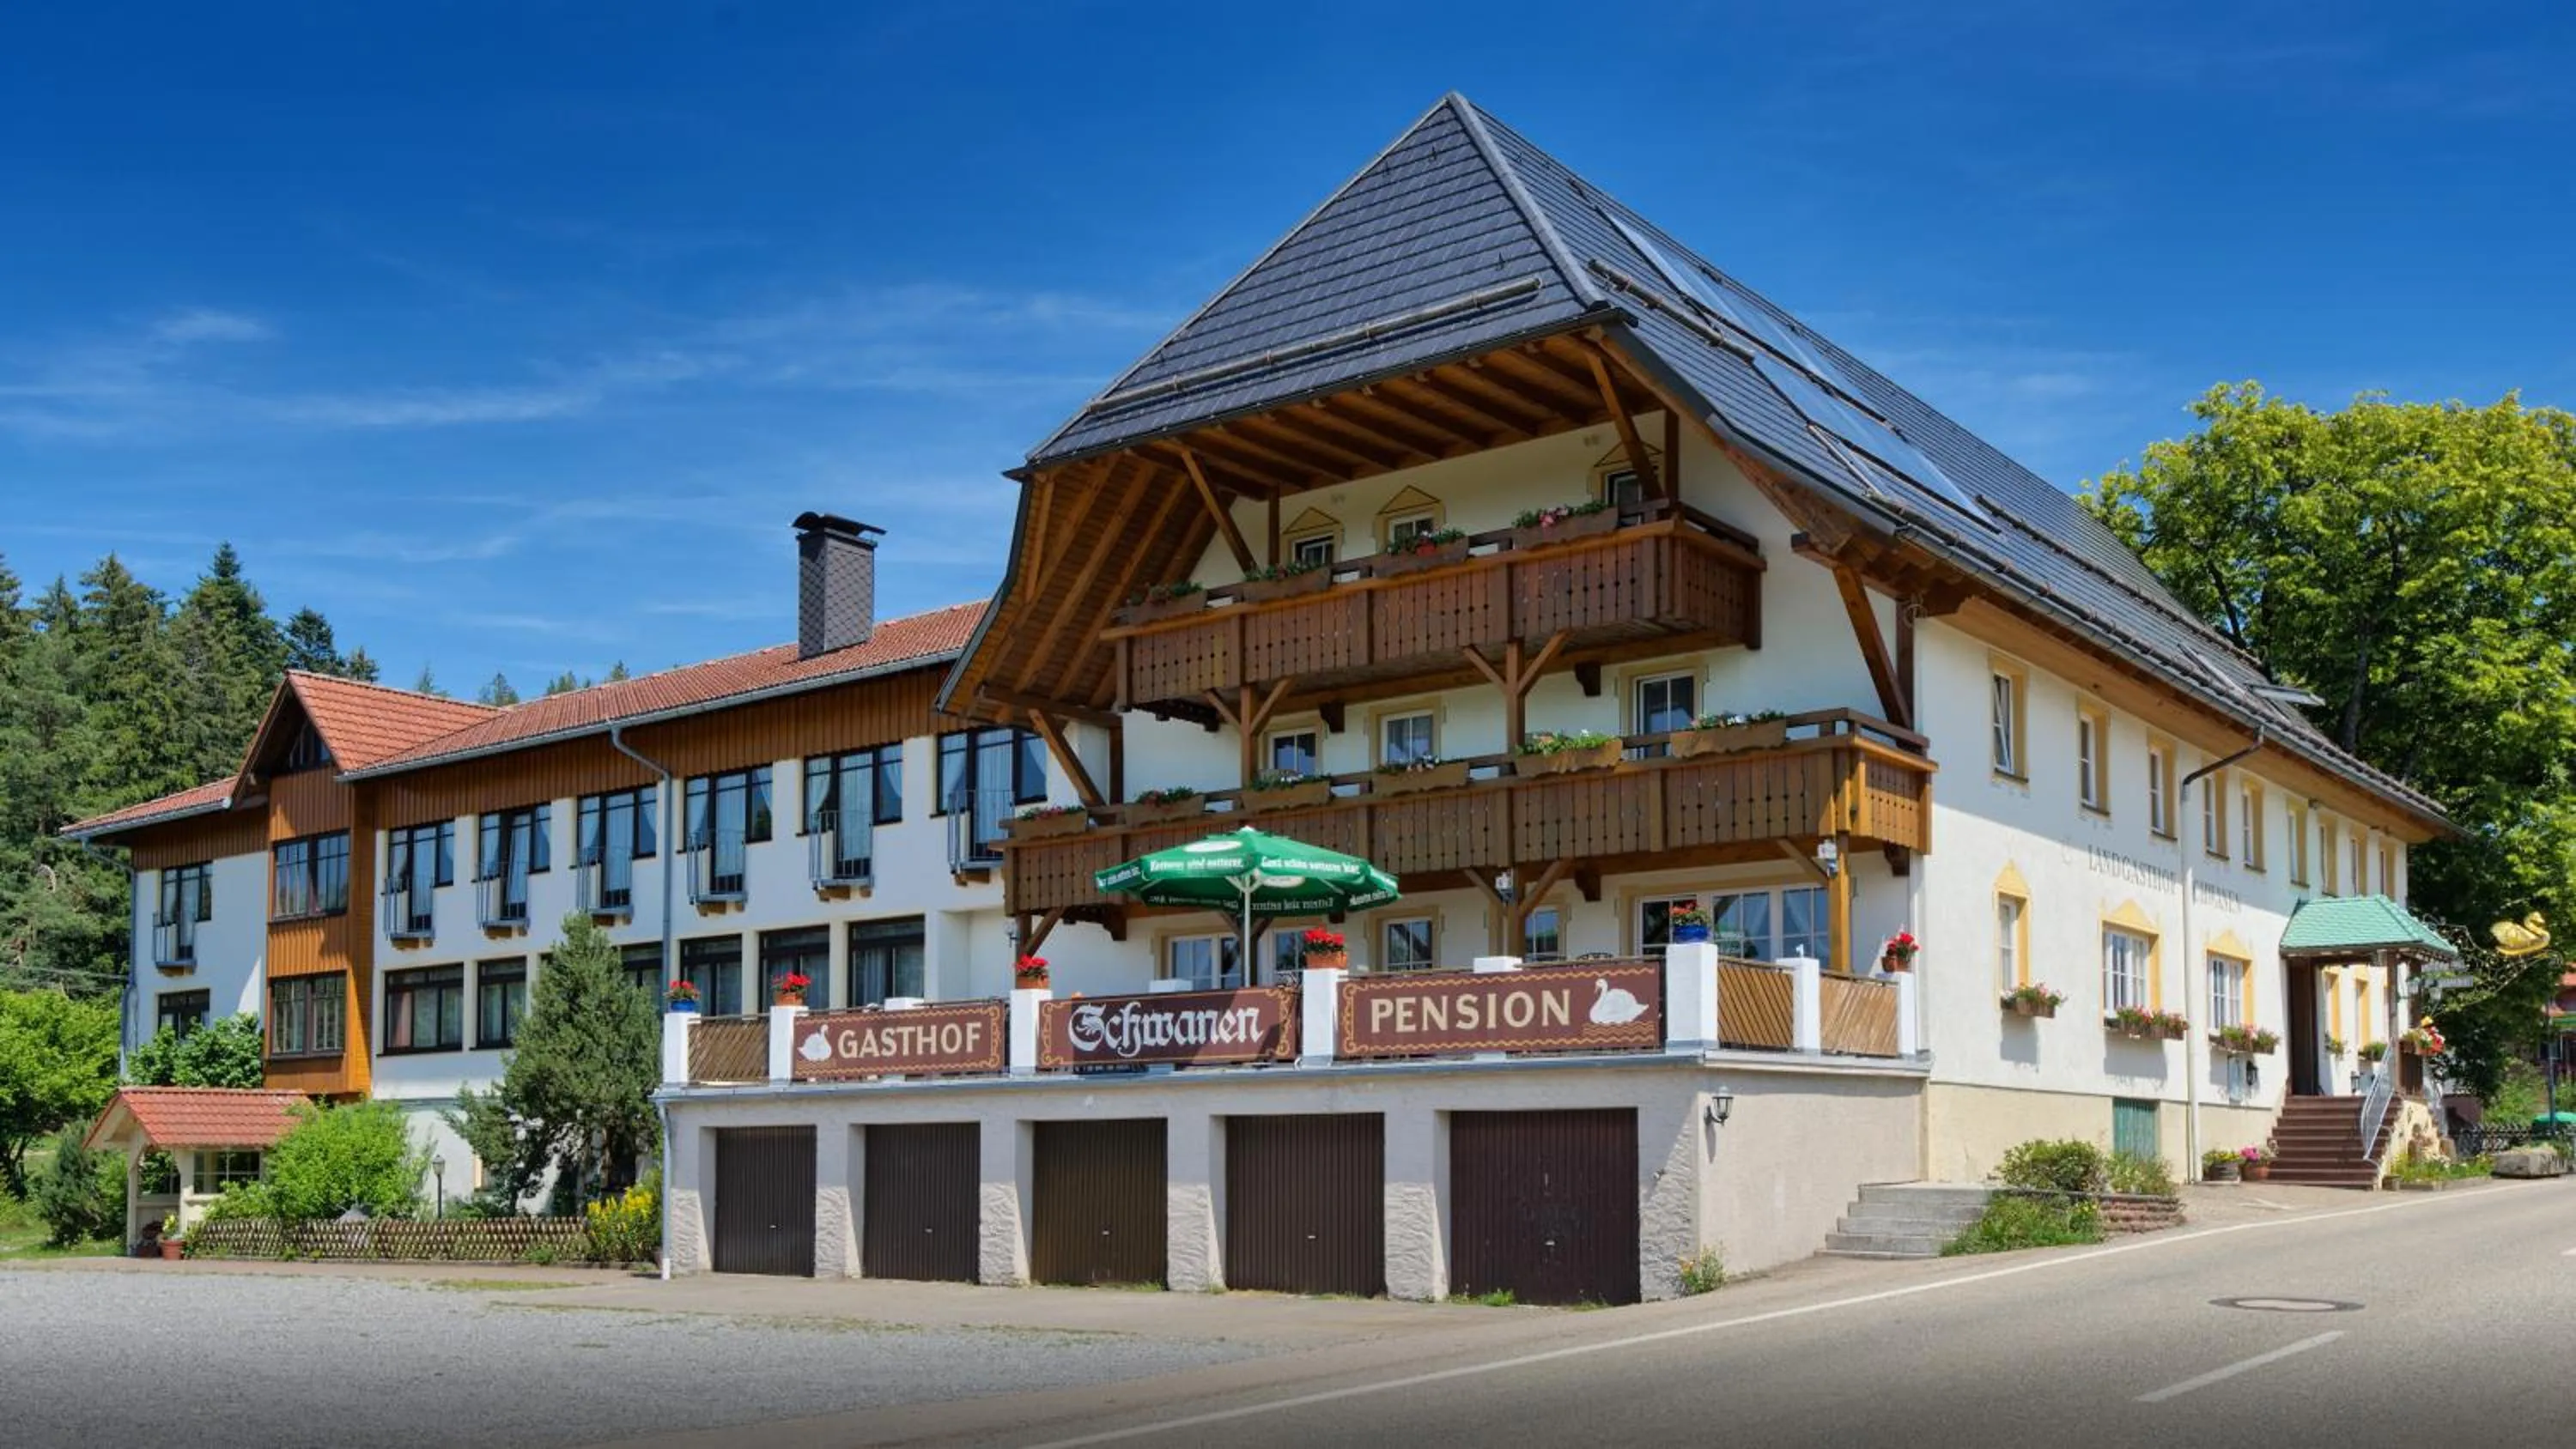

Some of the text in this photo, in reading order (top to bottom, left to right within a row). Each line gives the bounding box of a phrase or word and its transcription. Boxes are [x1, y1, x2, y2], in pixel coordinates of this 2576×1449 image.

[1068, 1001, 1265, 1058] Schwanen
[1370, 989, 1571, 1034] PENSION
[837, 1022, 982, 1059] GASTHOF
